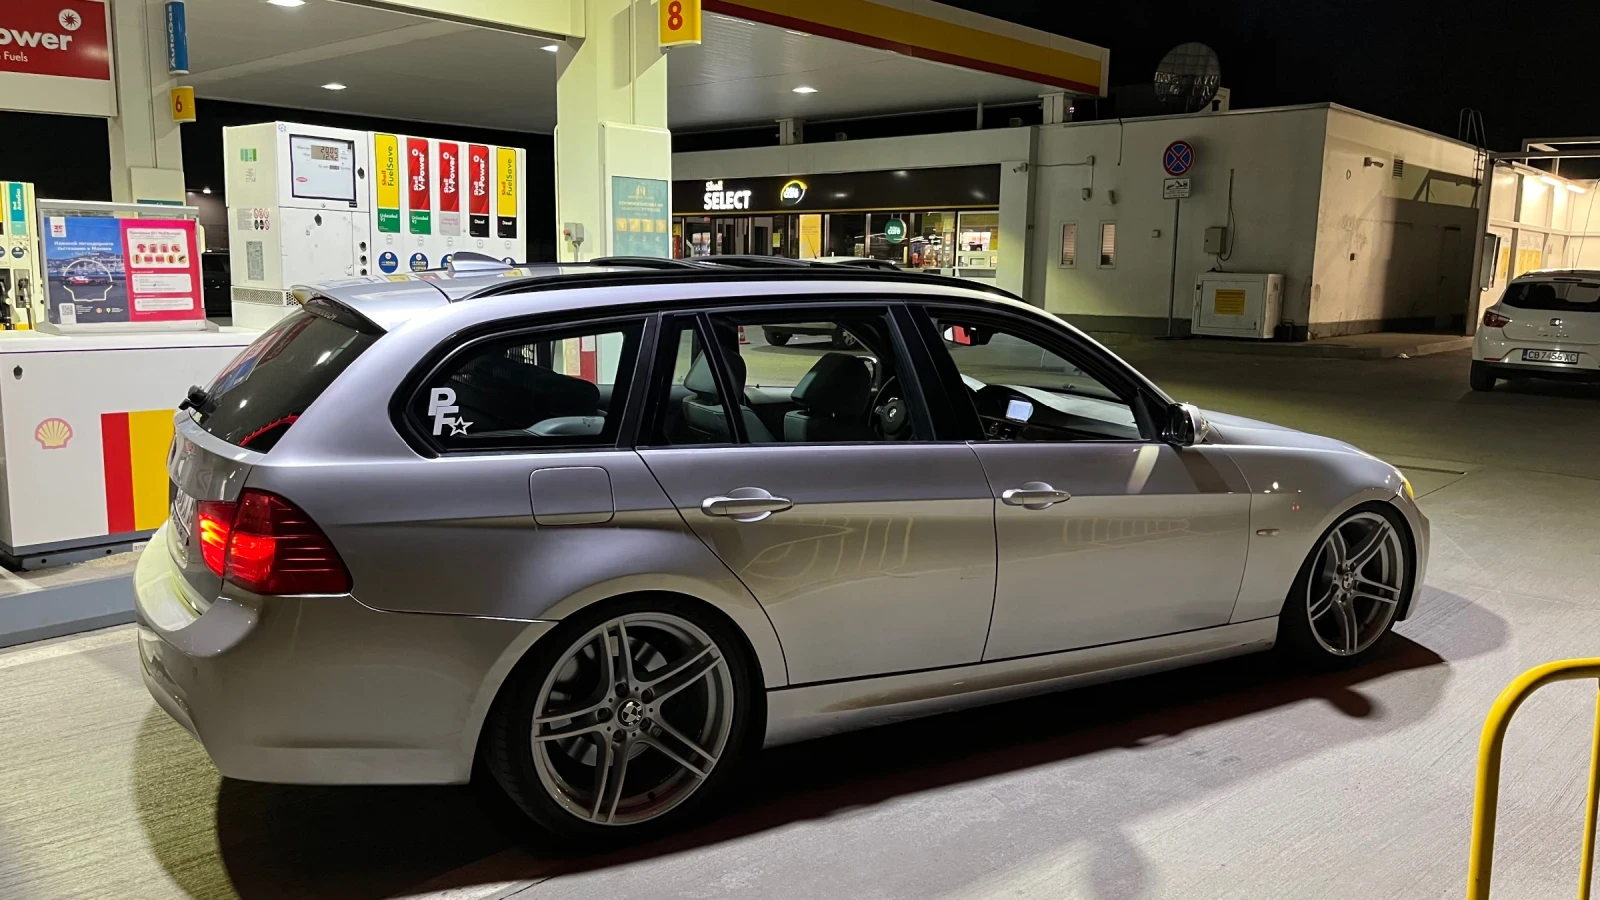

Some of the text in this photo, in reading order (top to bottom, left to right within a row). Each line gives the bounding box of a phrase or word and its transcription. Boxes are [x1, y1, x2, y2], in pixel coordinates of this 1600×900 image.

[668, 0, 683, 31] 8
[168, 5, 176, 68] AutoGas
[4, 51, 29, 62] Fuels
[175, 95, 183, 113] 6
[387, 145, 395, 187] FuelSave
[418, 152, 426, 191] V-Power
[448, 156, 456, 193] V-Power
[478, 158, 486, 196] V-Power
[704, 190, 752, 210] SELECT
[706, 180, 724, 191] Shell
[1528, 350, 1540, 359] CB
